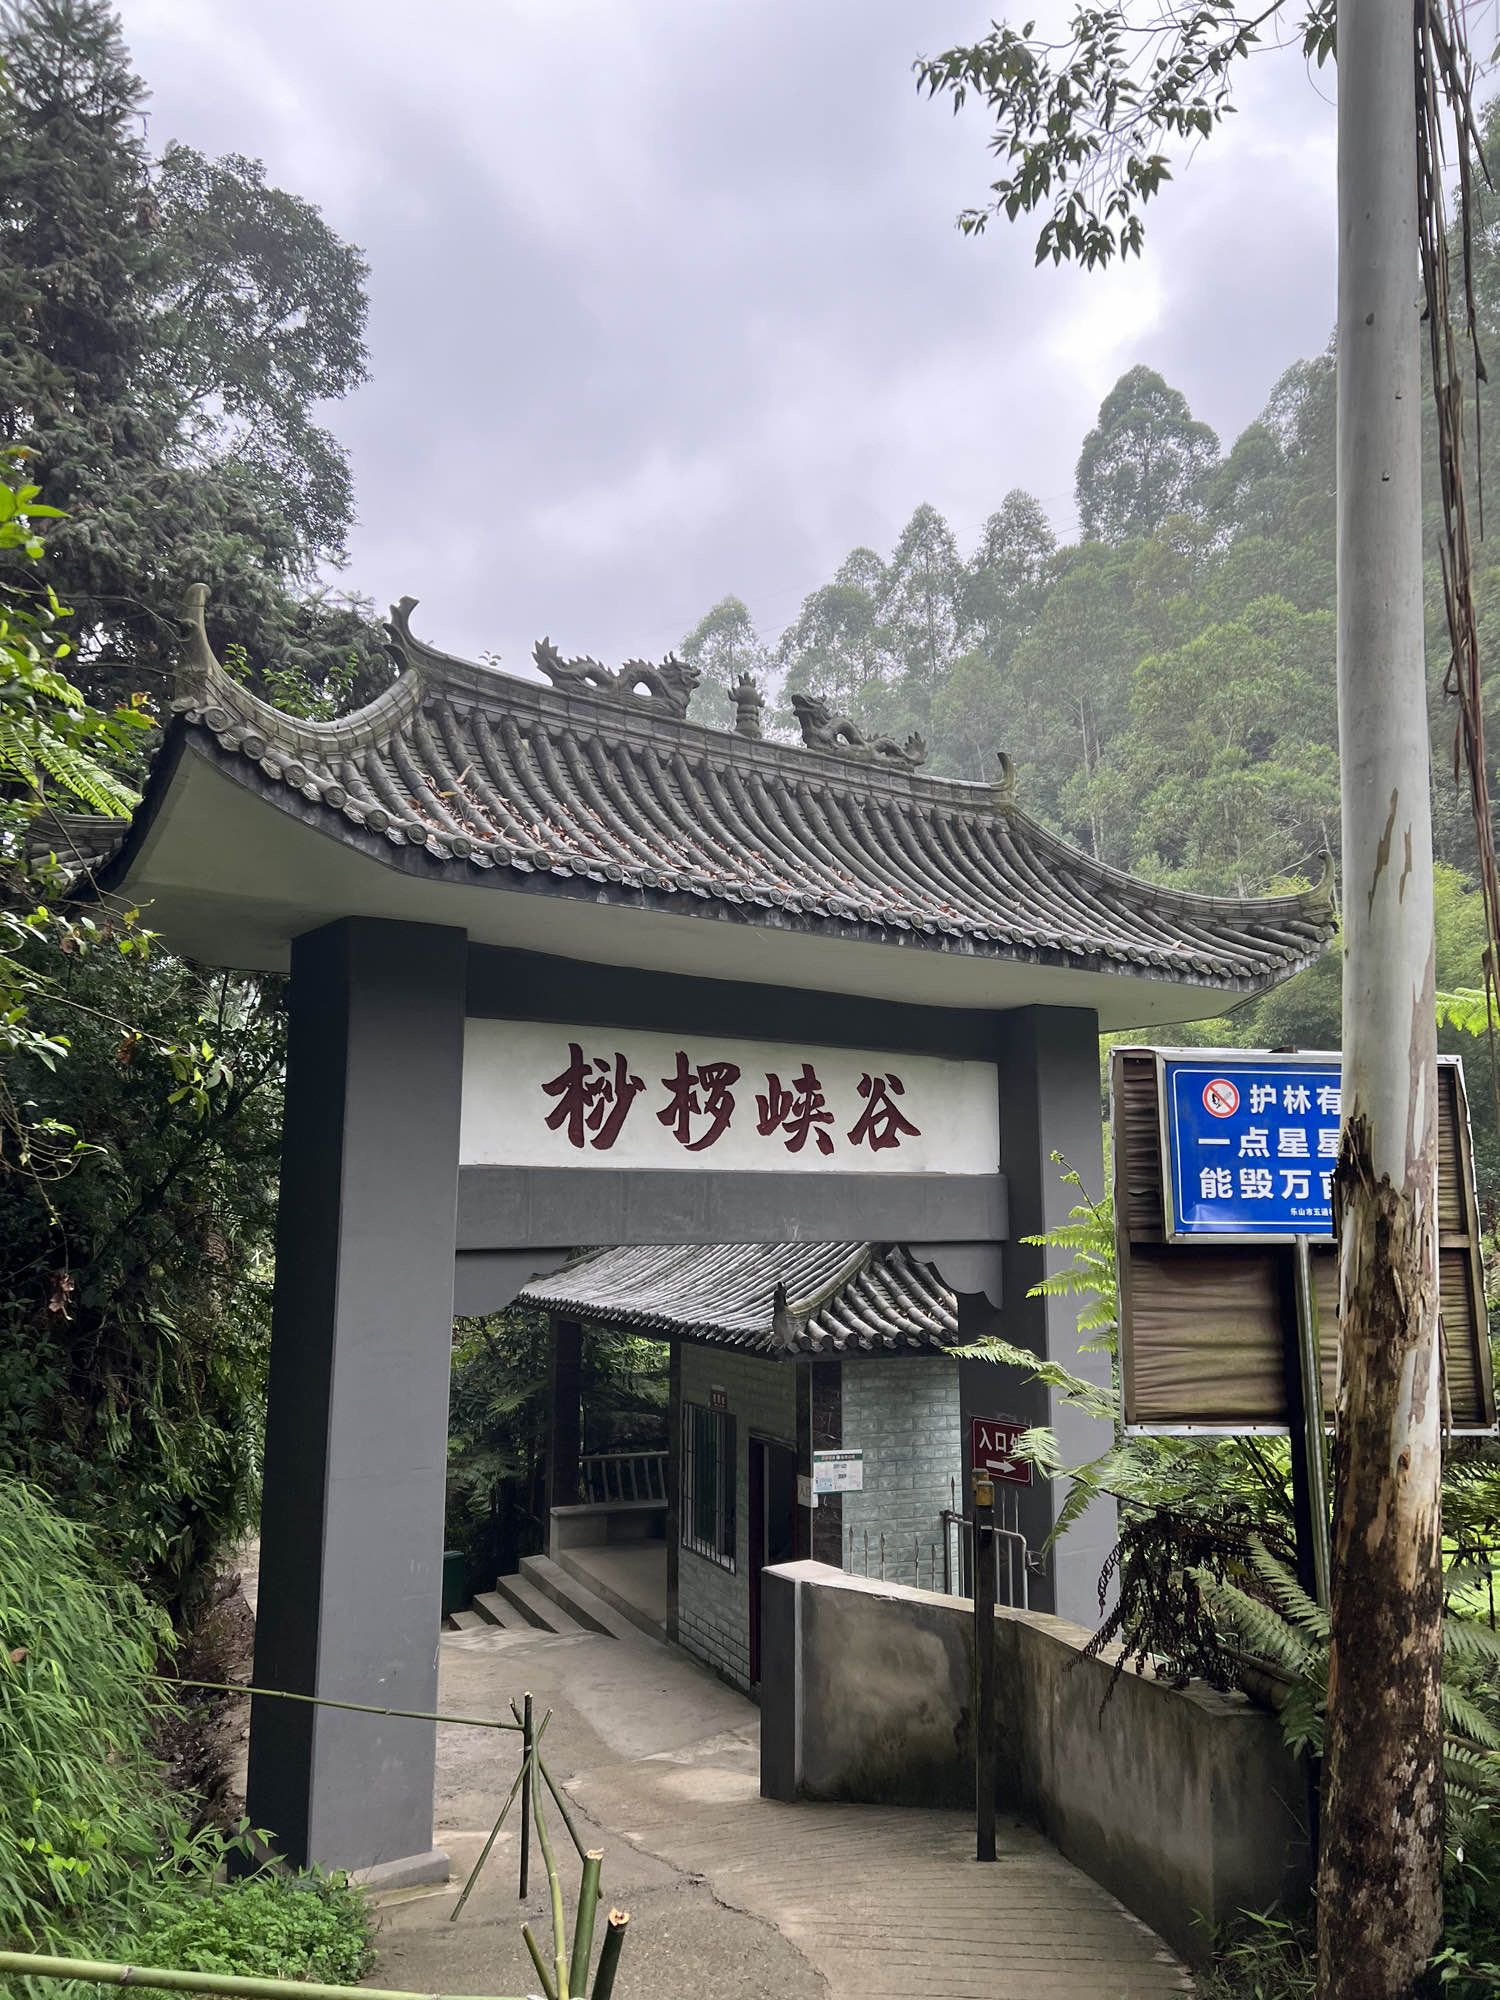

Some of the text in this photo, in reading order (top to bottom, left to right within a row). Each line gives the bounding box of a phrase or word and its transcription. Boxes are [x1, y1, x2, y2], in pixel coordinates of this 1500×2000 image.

[542, 1043, 921, 1155] 桫椤峡谷
[1290, 1207, 1332, 1217] 乐山市五通
